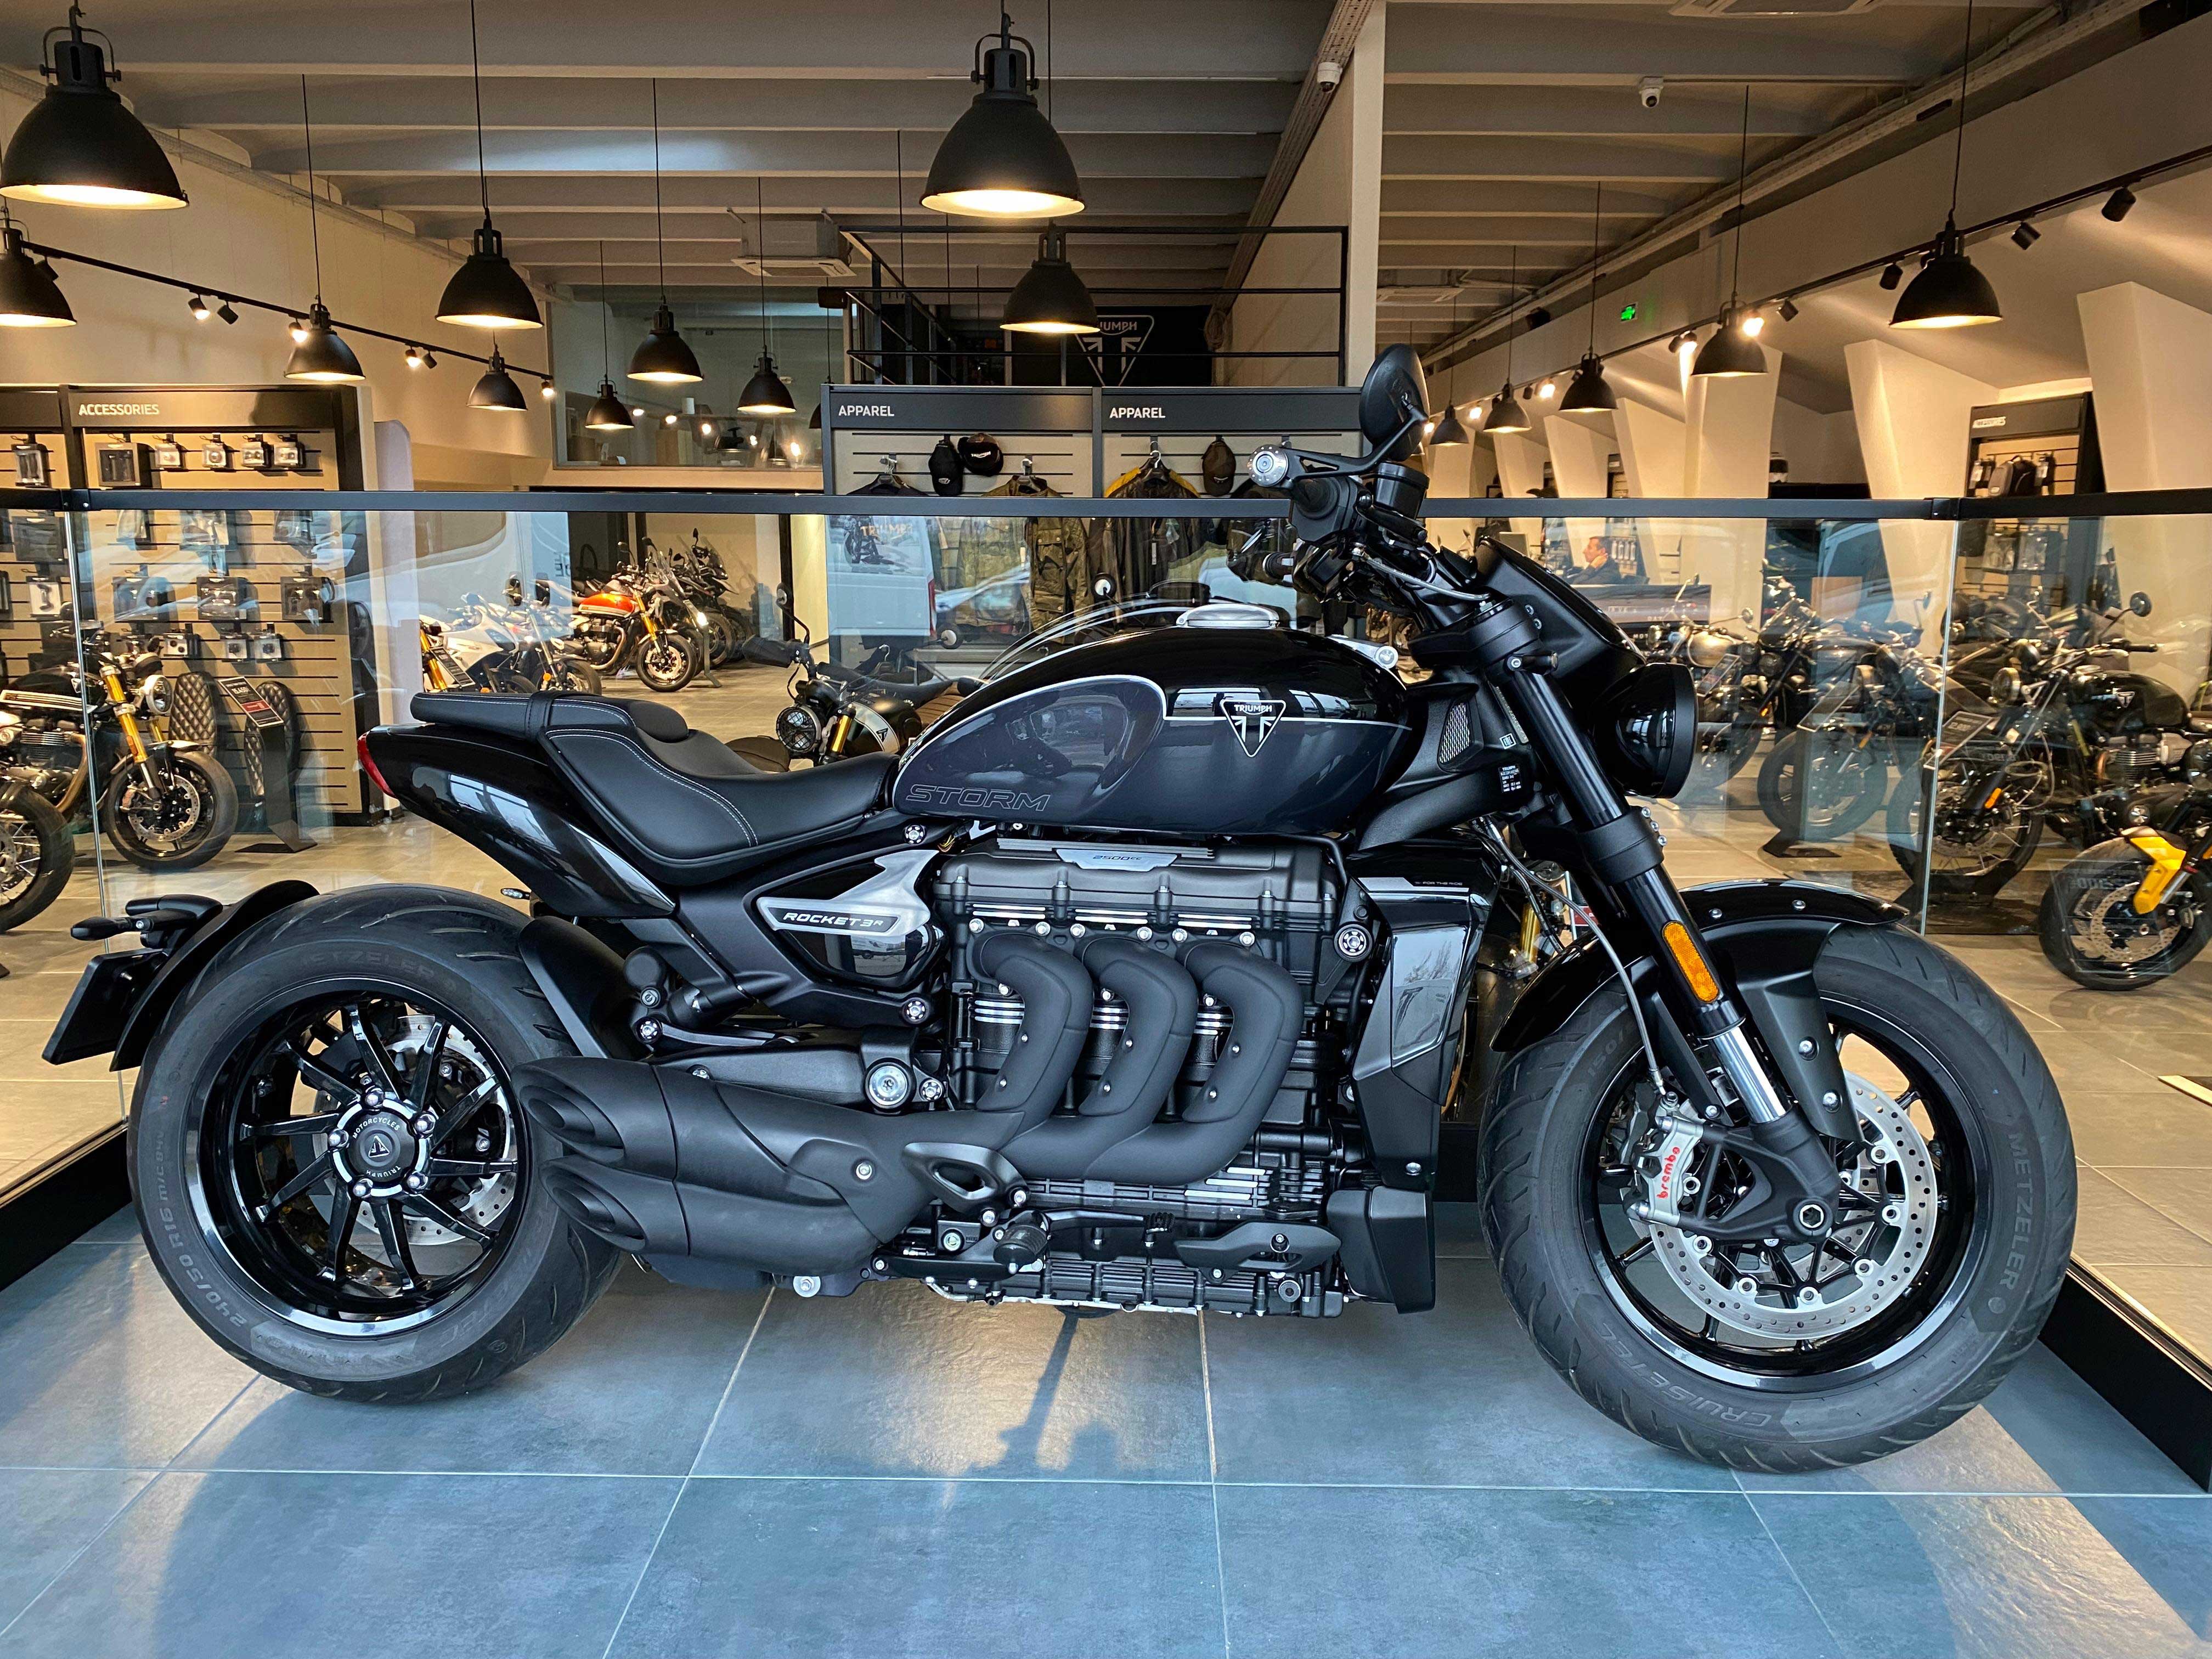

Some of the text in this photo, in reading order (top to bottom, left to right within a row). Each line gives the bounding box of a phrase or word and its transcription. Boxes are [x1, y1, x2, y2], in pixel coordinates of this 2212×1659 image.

[1099, 321, 1137, 330] IUMPH
[78, 403, 160, 416] ACCESSORIES
[838, 405, 895, 417] APPAREL
[1110, 407, 1166, 419] APPAREL
[906, 785, 1050, 811] STORM
[783, 912, 861, 926] ROCKET
[352, 1117, 400, 1139] MOTORCYCLES
[366, 1165, 401, 1178] TRIUMPH
[1656, 1147, 1680, 1199] brembo
[2000, 1133, 2034, 1291] METZELER
[1601, 1321, 1771, 1427] CRUISETEC
